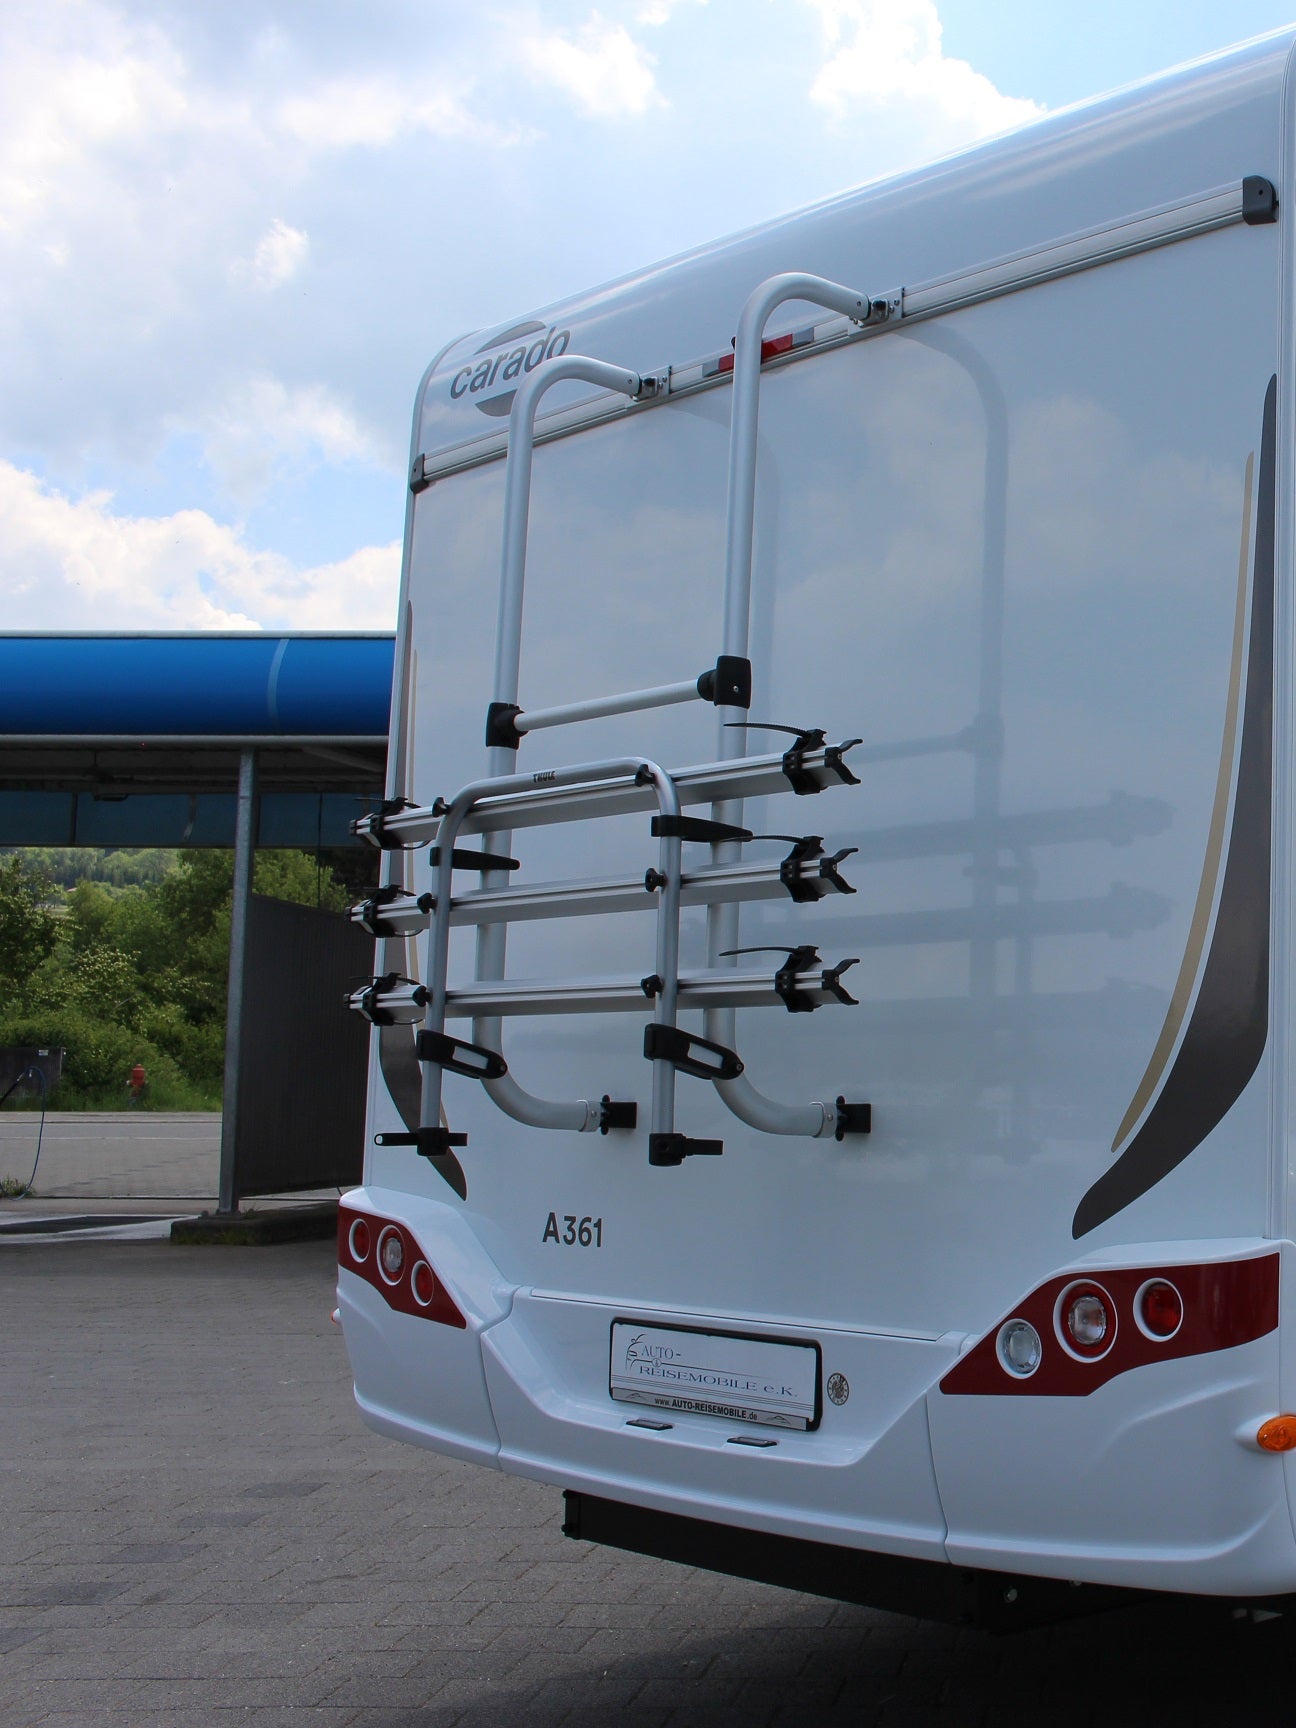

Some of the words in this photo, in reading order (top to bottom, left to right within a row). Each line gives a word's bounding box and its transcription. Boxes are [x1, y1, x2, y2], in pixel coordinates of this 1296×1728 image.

[450, 326, 571, 399] carado
[533, 770, 556, 783] THULE
[542, 1211, 603, 1248] A361
[639, 1366, 758, 1391] REISEMOBILE
[763, 1384, 798, 1398] e.K.
